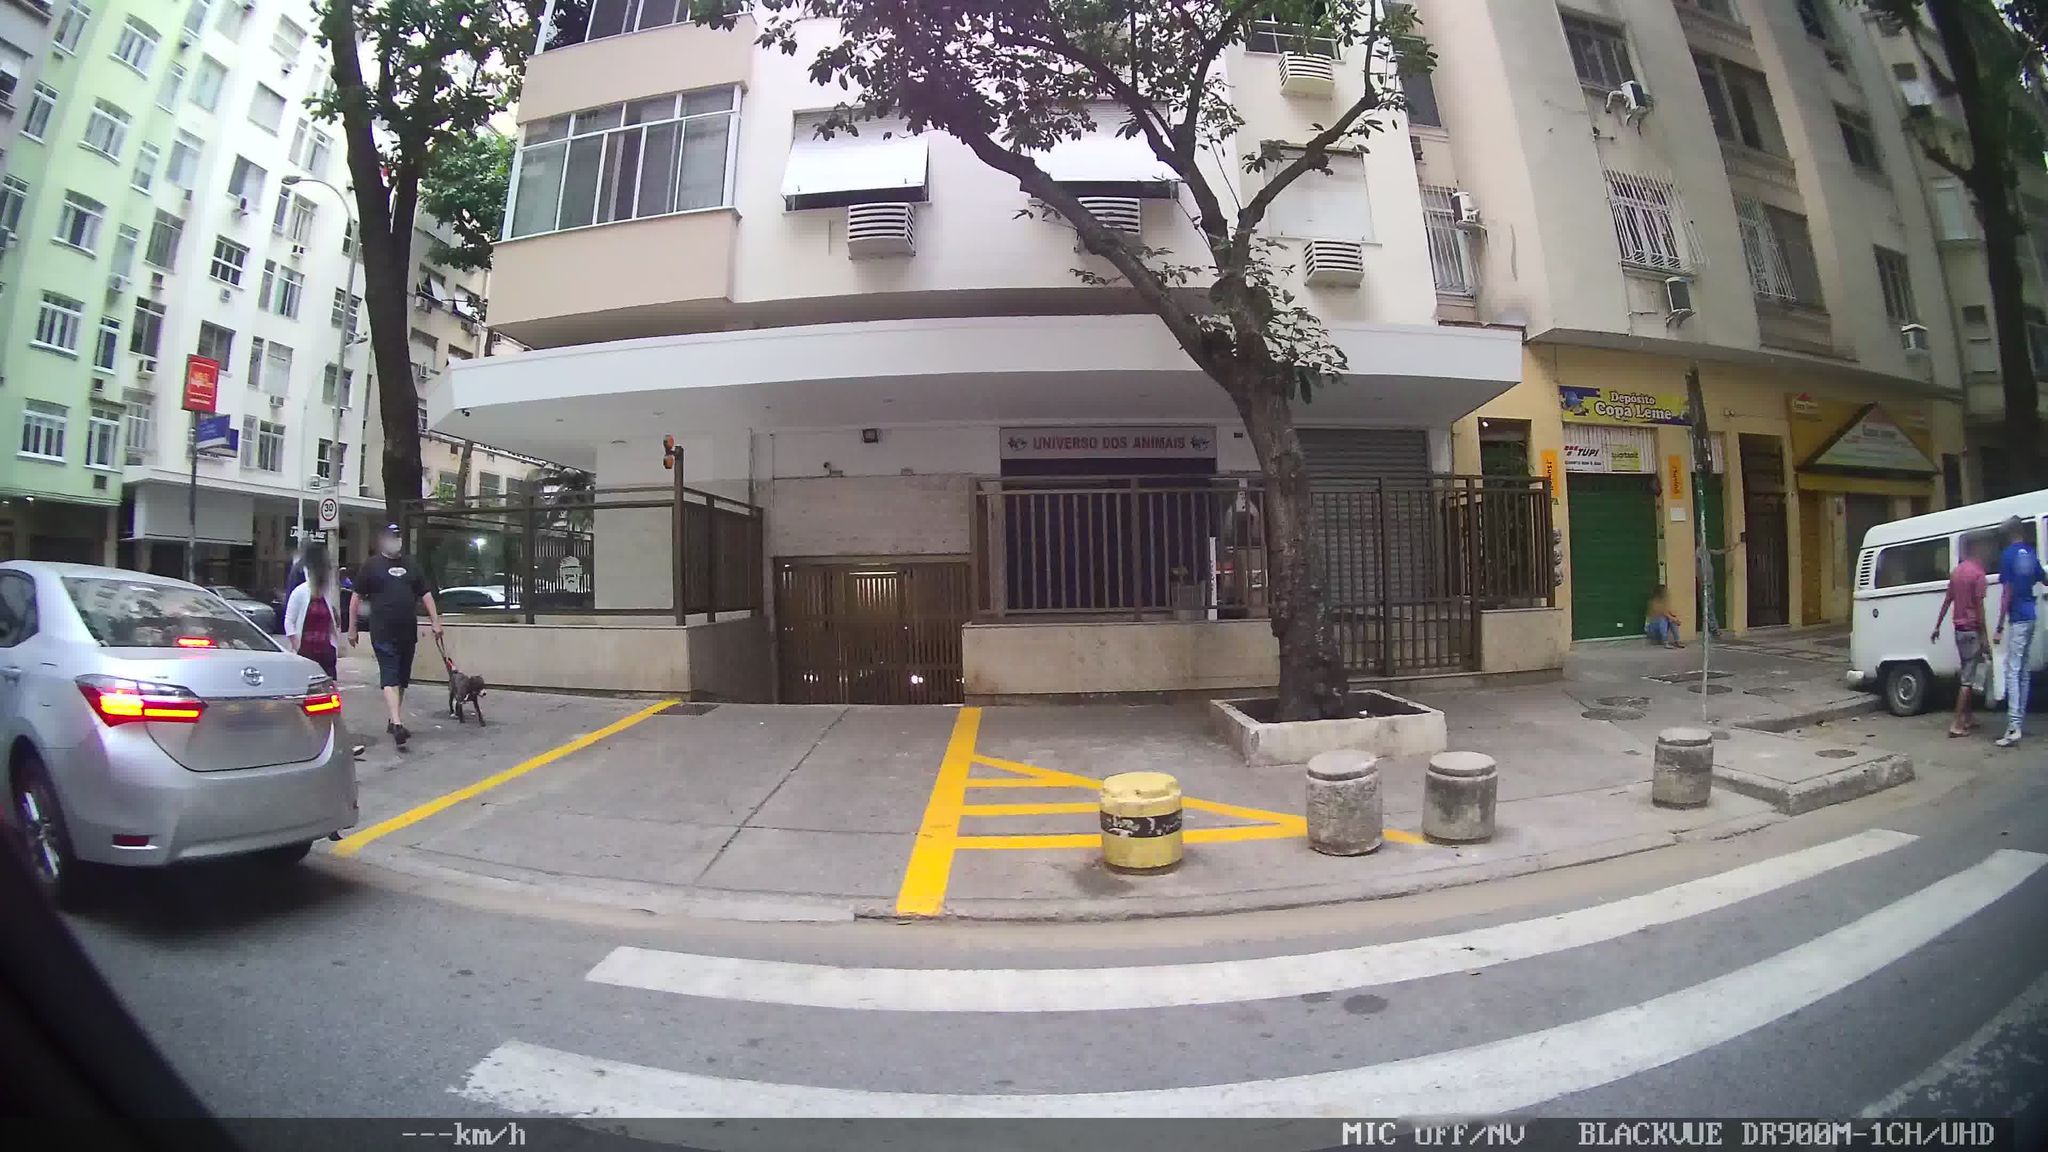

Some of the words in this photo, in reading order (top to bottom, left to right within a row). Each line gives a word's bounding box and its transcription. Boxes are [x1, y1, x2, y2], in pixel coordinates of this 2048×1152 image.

[1610, 390, 1656, 405] Depósito
[1594, 401, 1633, 420] Copa
[1635, 404, 1673, 420] Leme
[1032, 436, 1098, 450] UNIVERSO
[1103, 436, 1128, 449] DOS
[1132, 435, 1186, 449] ANIMAIS
[324, 503, 334, 512] 30
